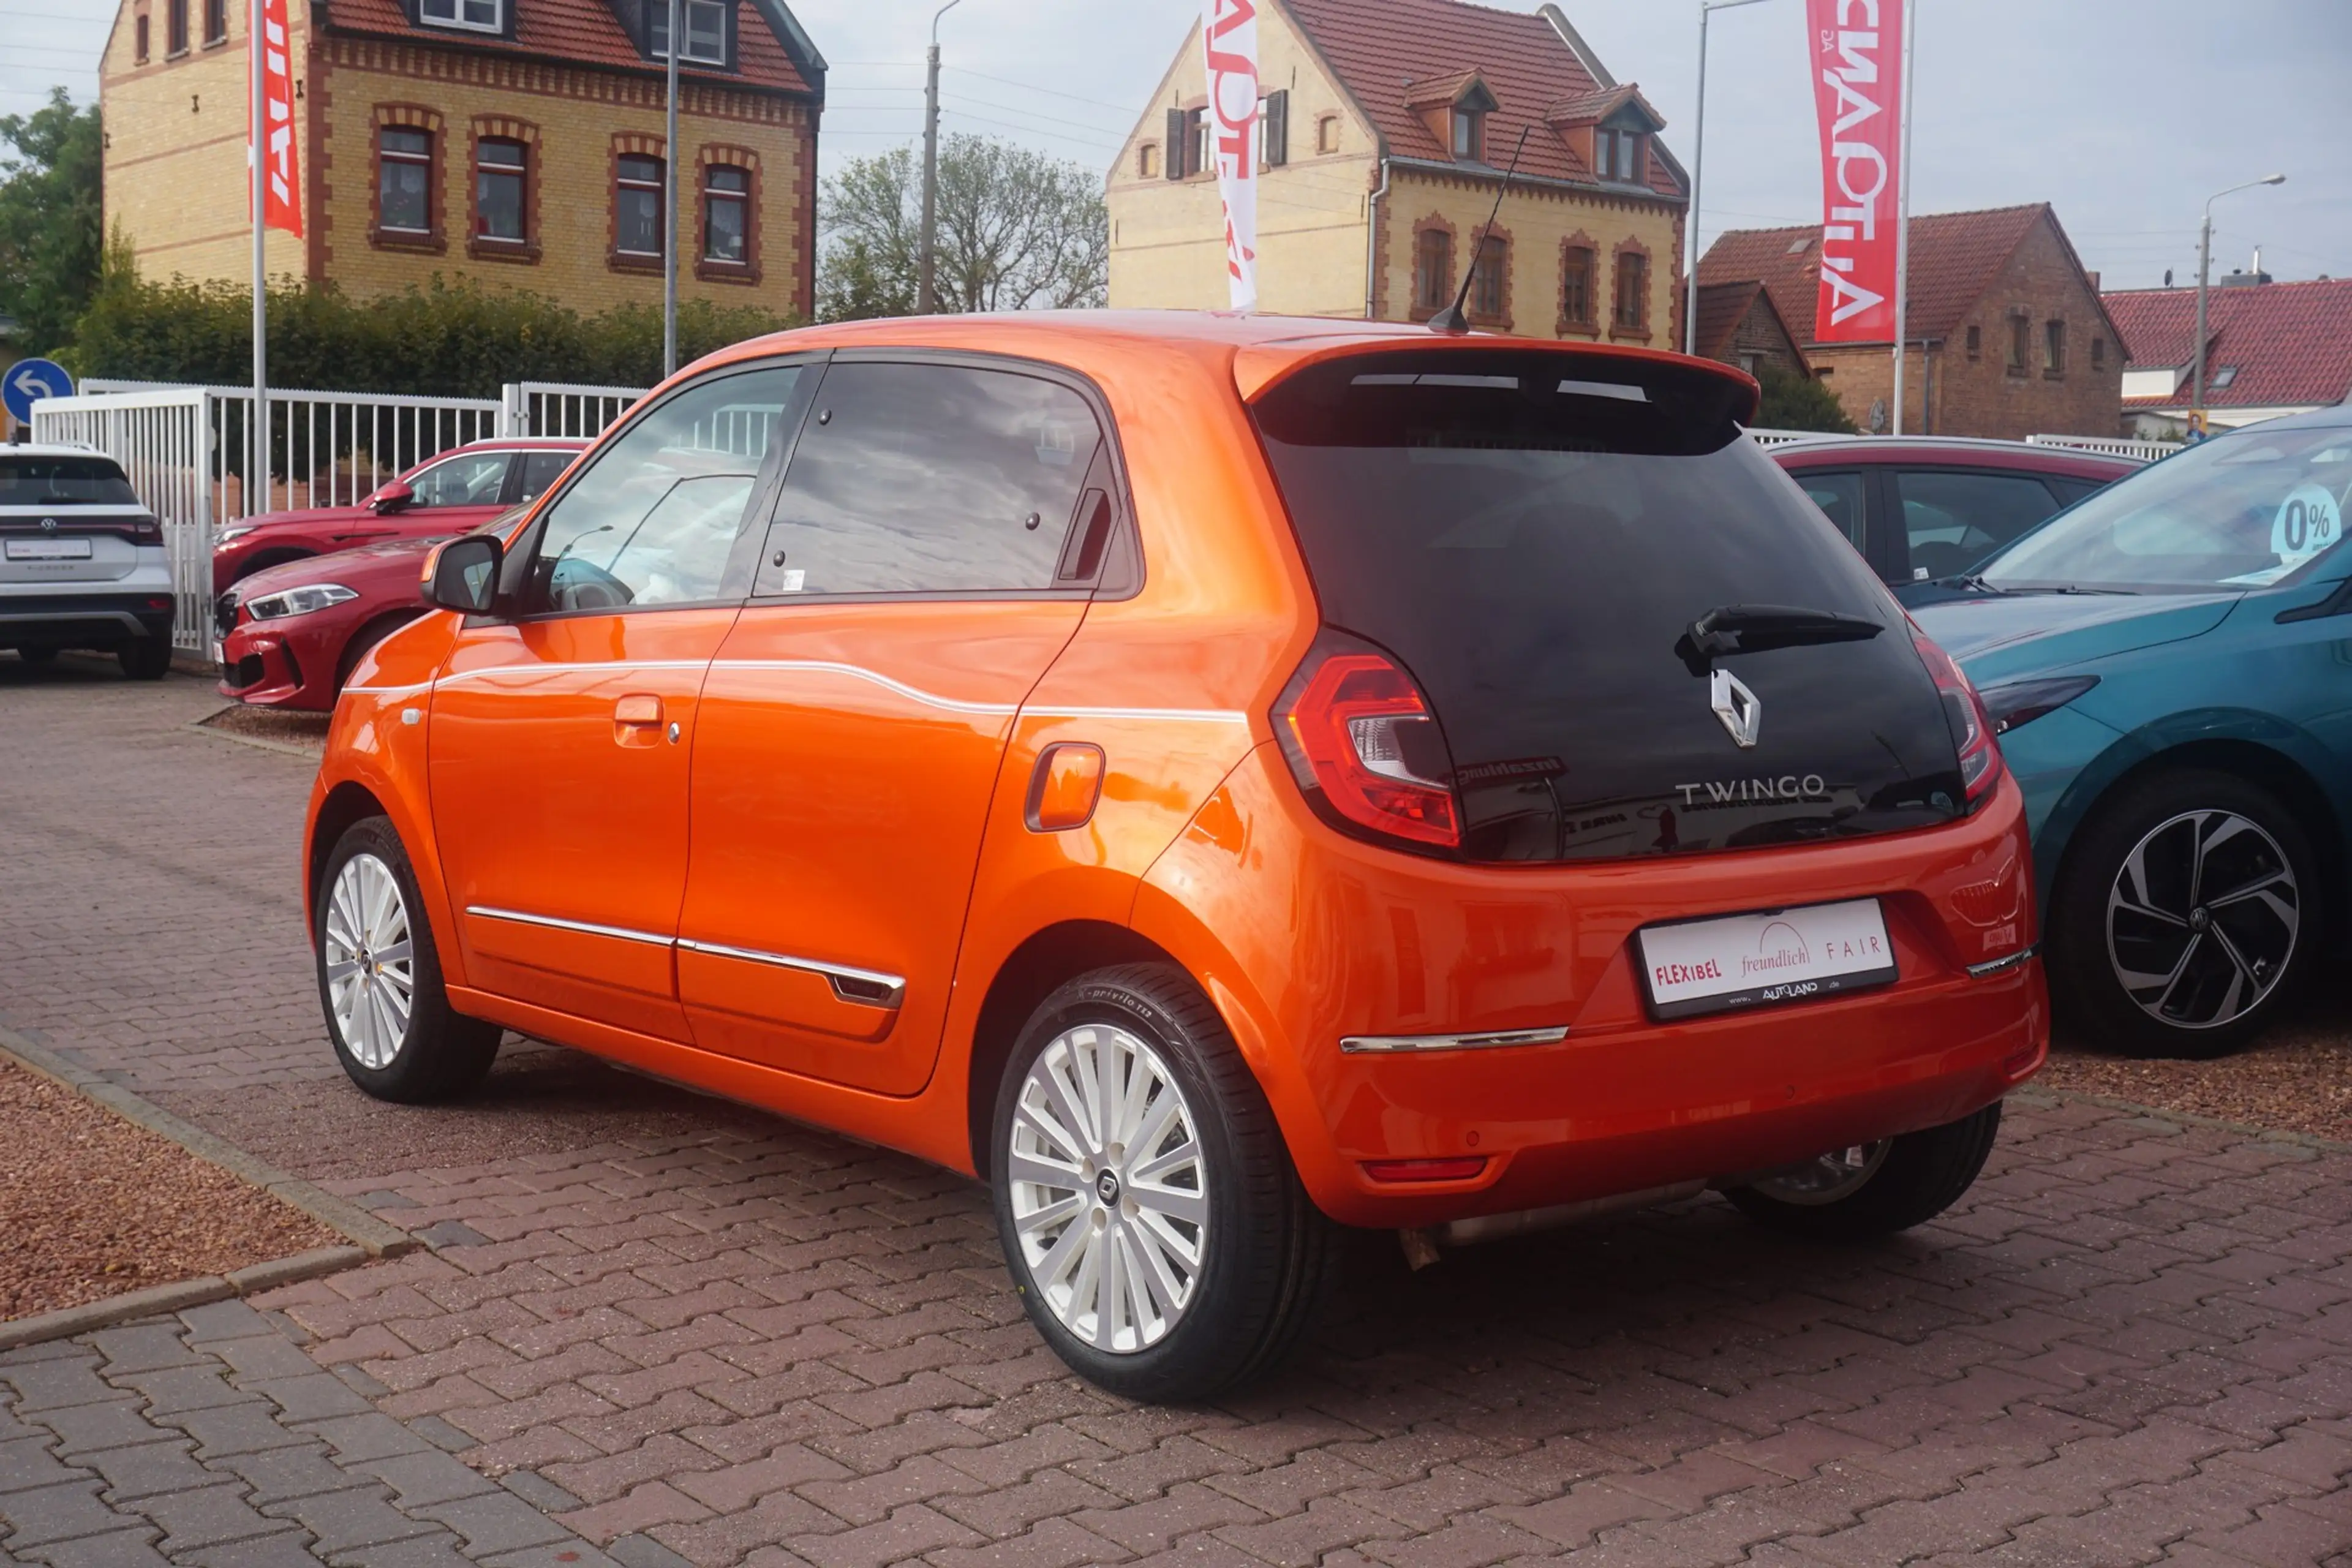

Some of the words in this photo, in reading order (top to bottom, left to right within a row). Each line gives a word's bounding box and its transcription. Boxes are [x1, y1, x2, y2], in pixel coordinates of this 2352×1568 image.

[2285, 499, 2330, 551] 0%
[1675, 774, 1825, 805] TWINGO
[1656, 959, 1722, 986] FLEXIBEL
[1741, 948, 1807, 978] freundlich
[1826, 936, 1881, 960] FAIR
[1762, 982, 1819, 1000] AUTOLAND
